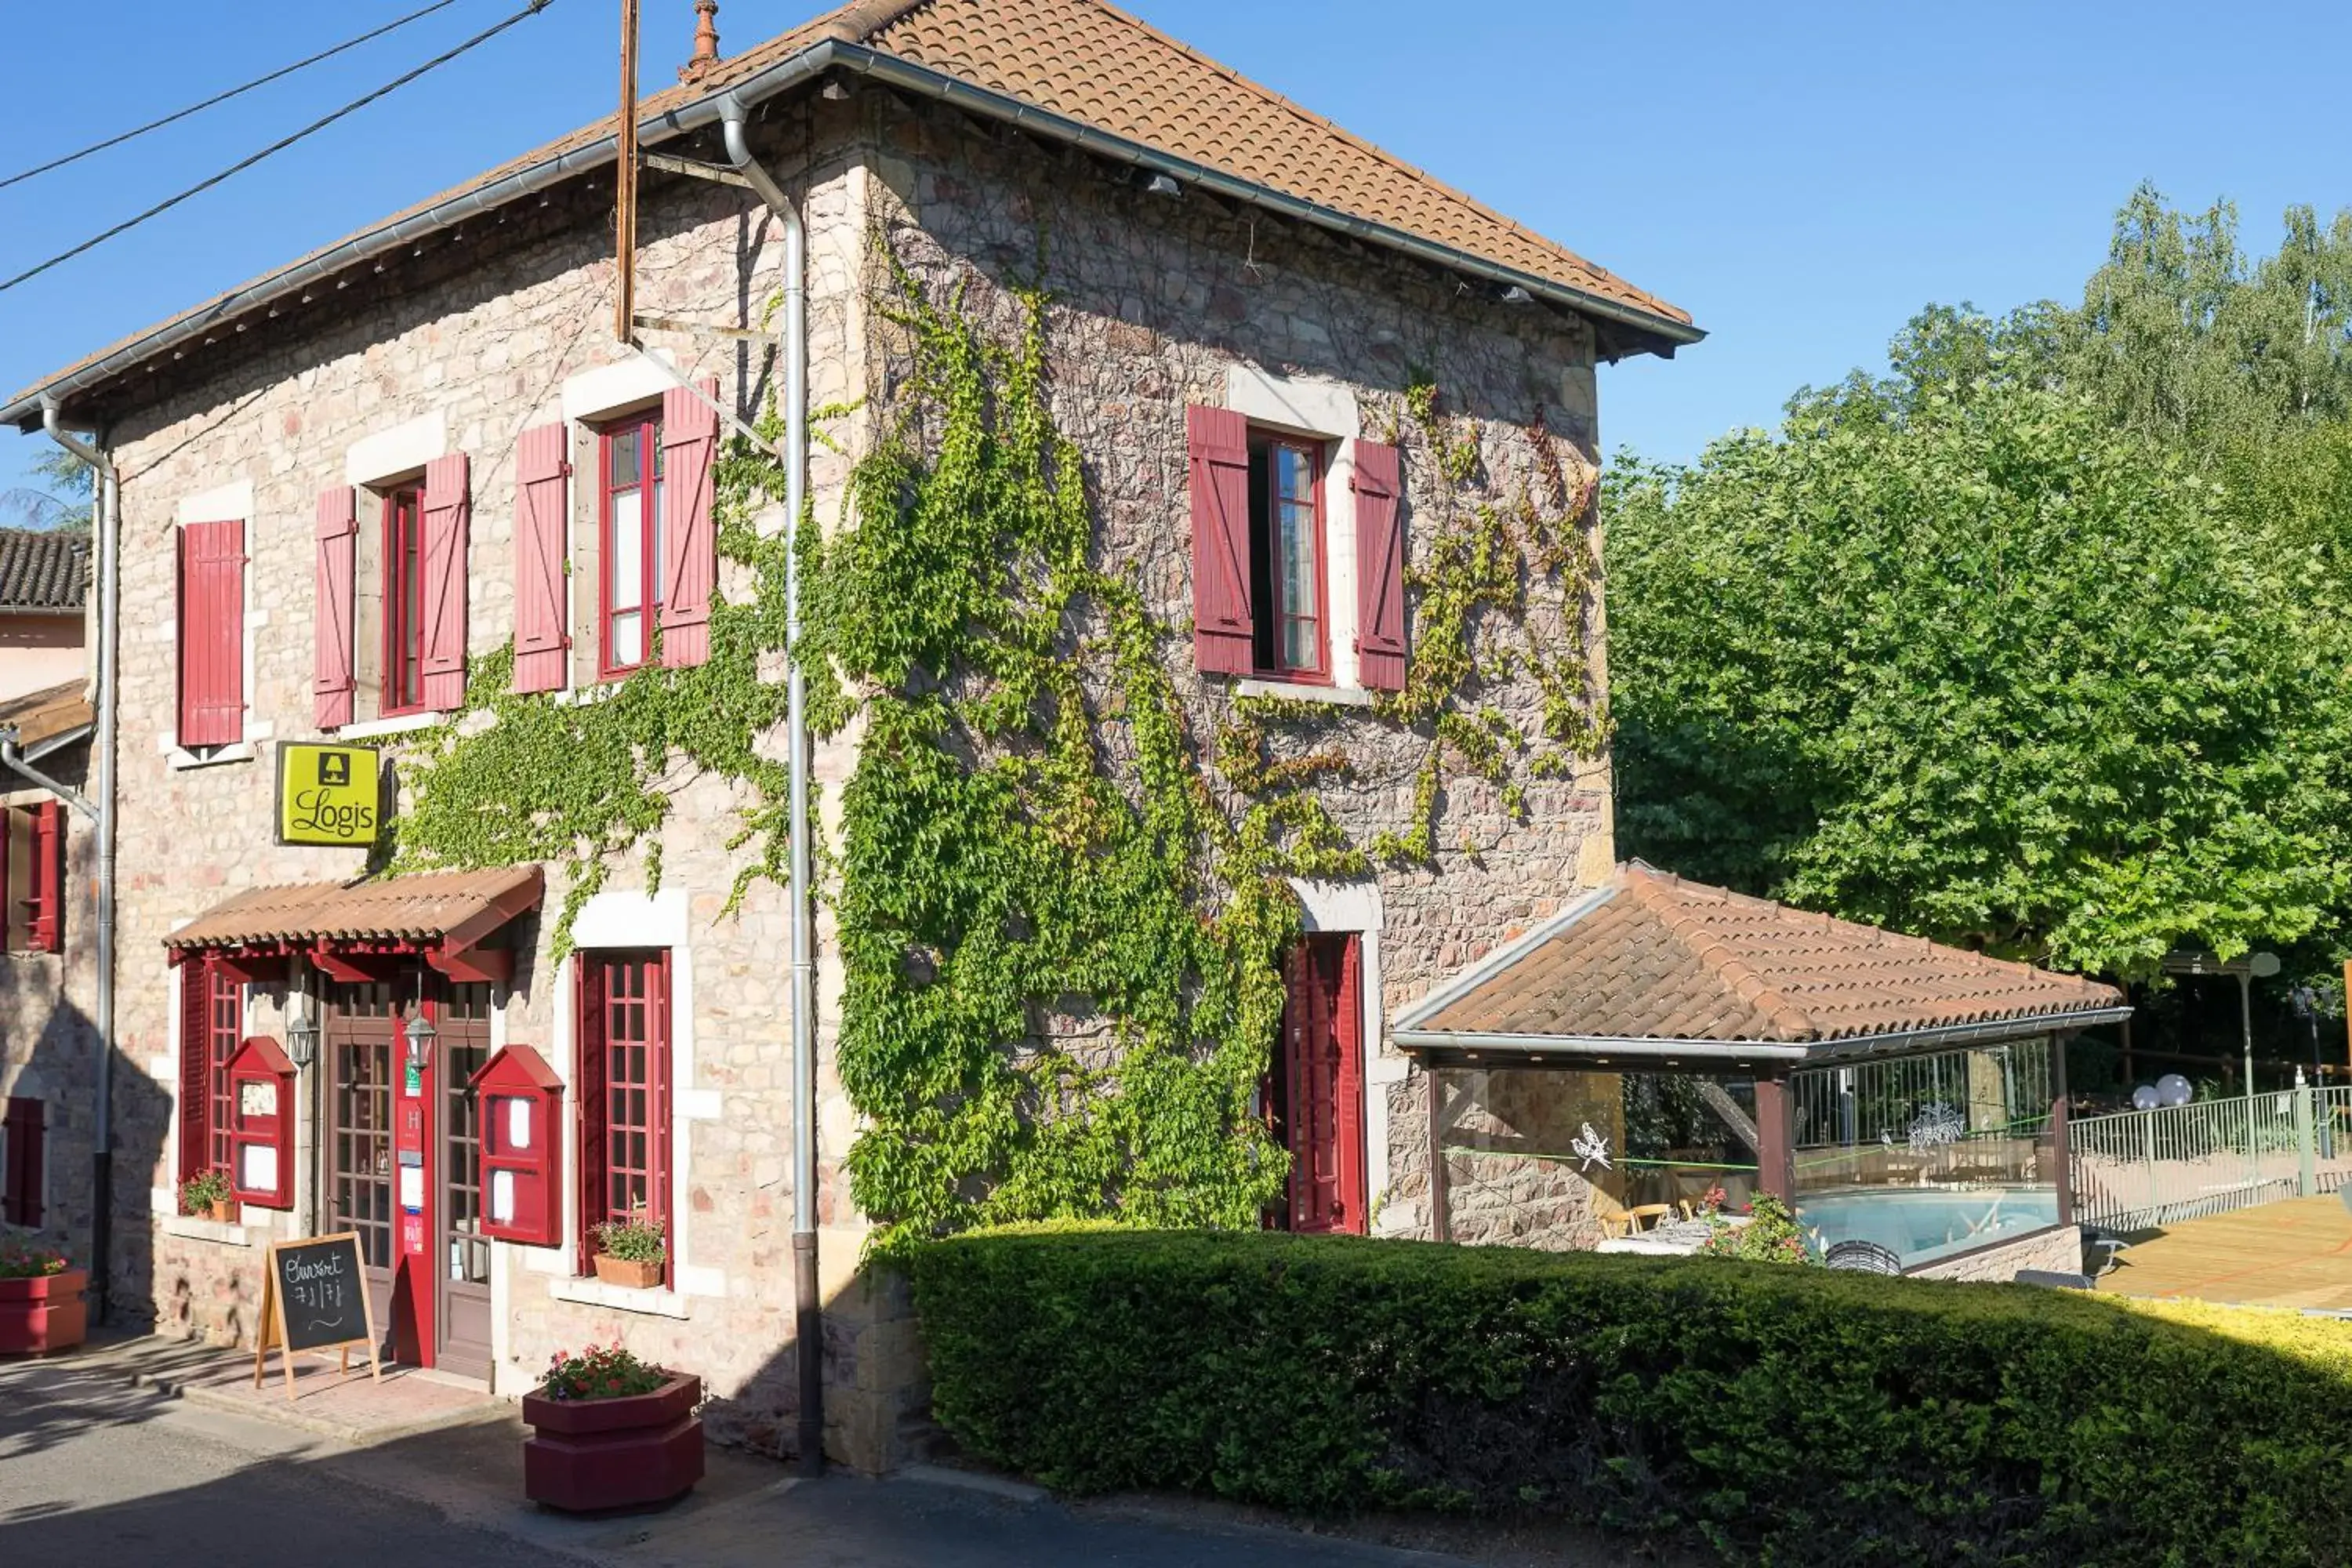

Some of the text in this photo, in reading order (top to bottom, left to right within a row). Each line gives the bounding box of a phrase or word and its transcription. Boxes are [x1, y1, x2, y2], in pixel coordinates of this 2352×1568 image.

[291, 787, 373, 837] Logis
[408, 1110, 419, 1130] H
[285, 1250, 344, 1283] Ouvert
